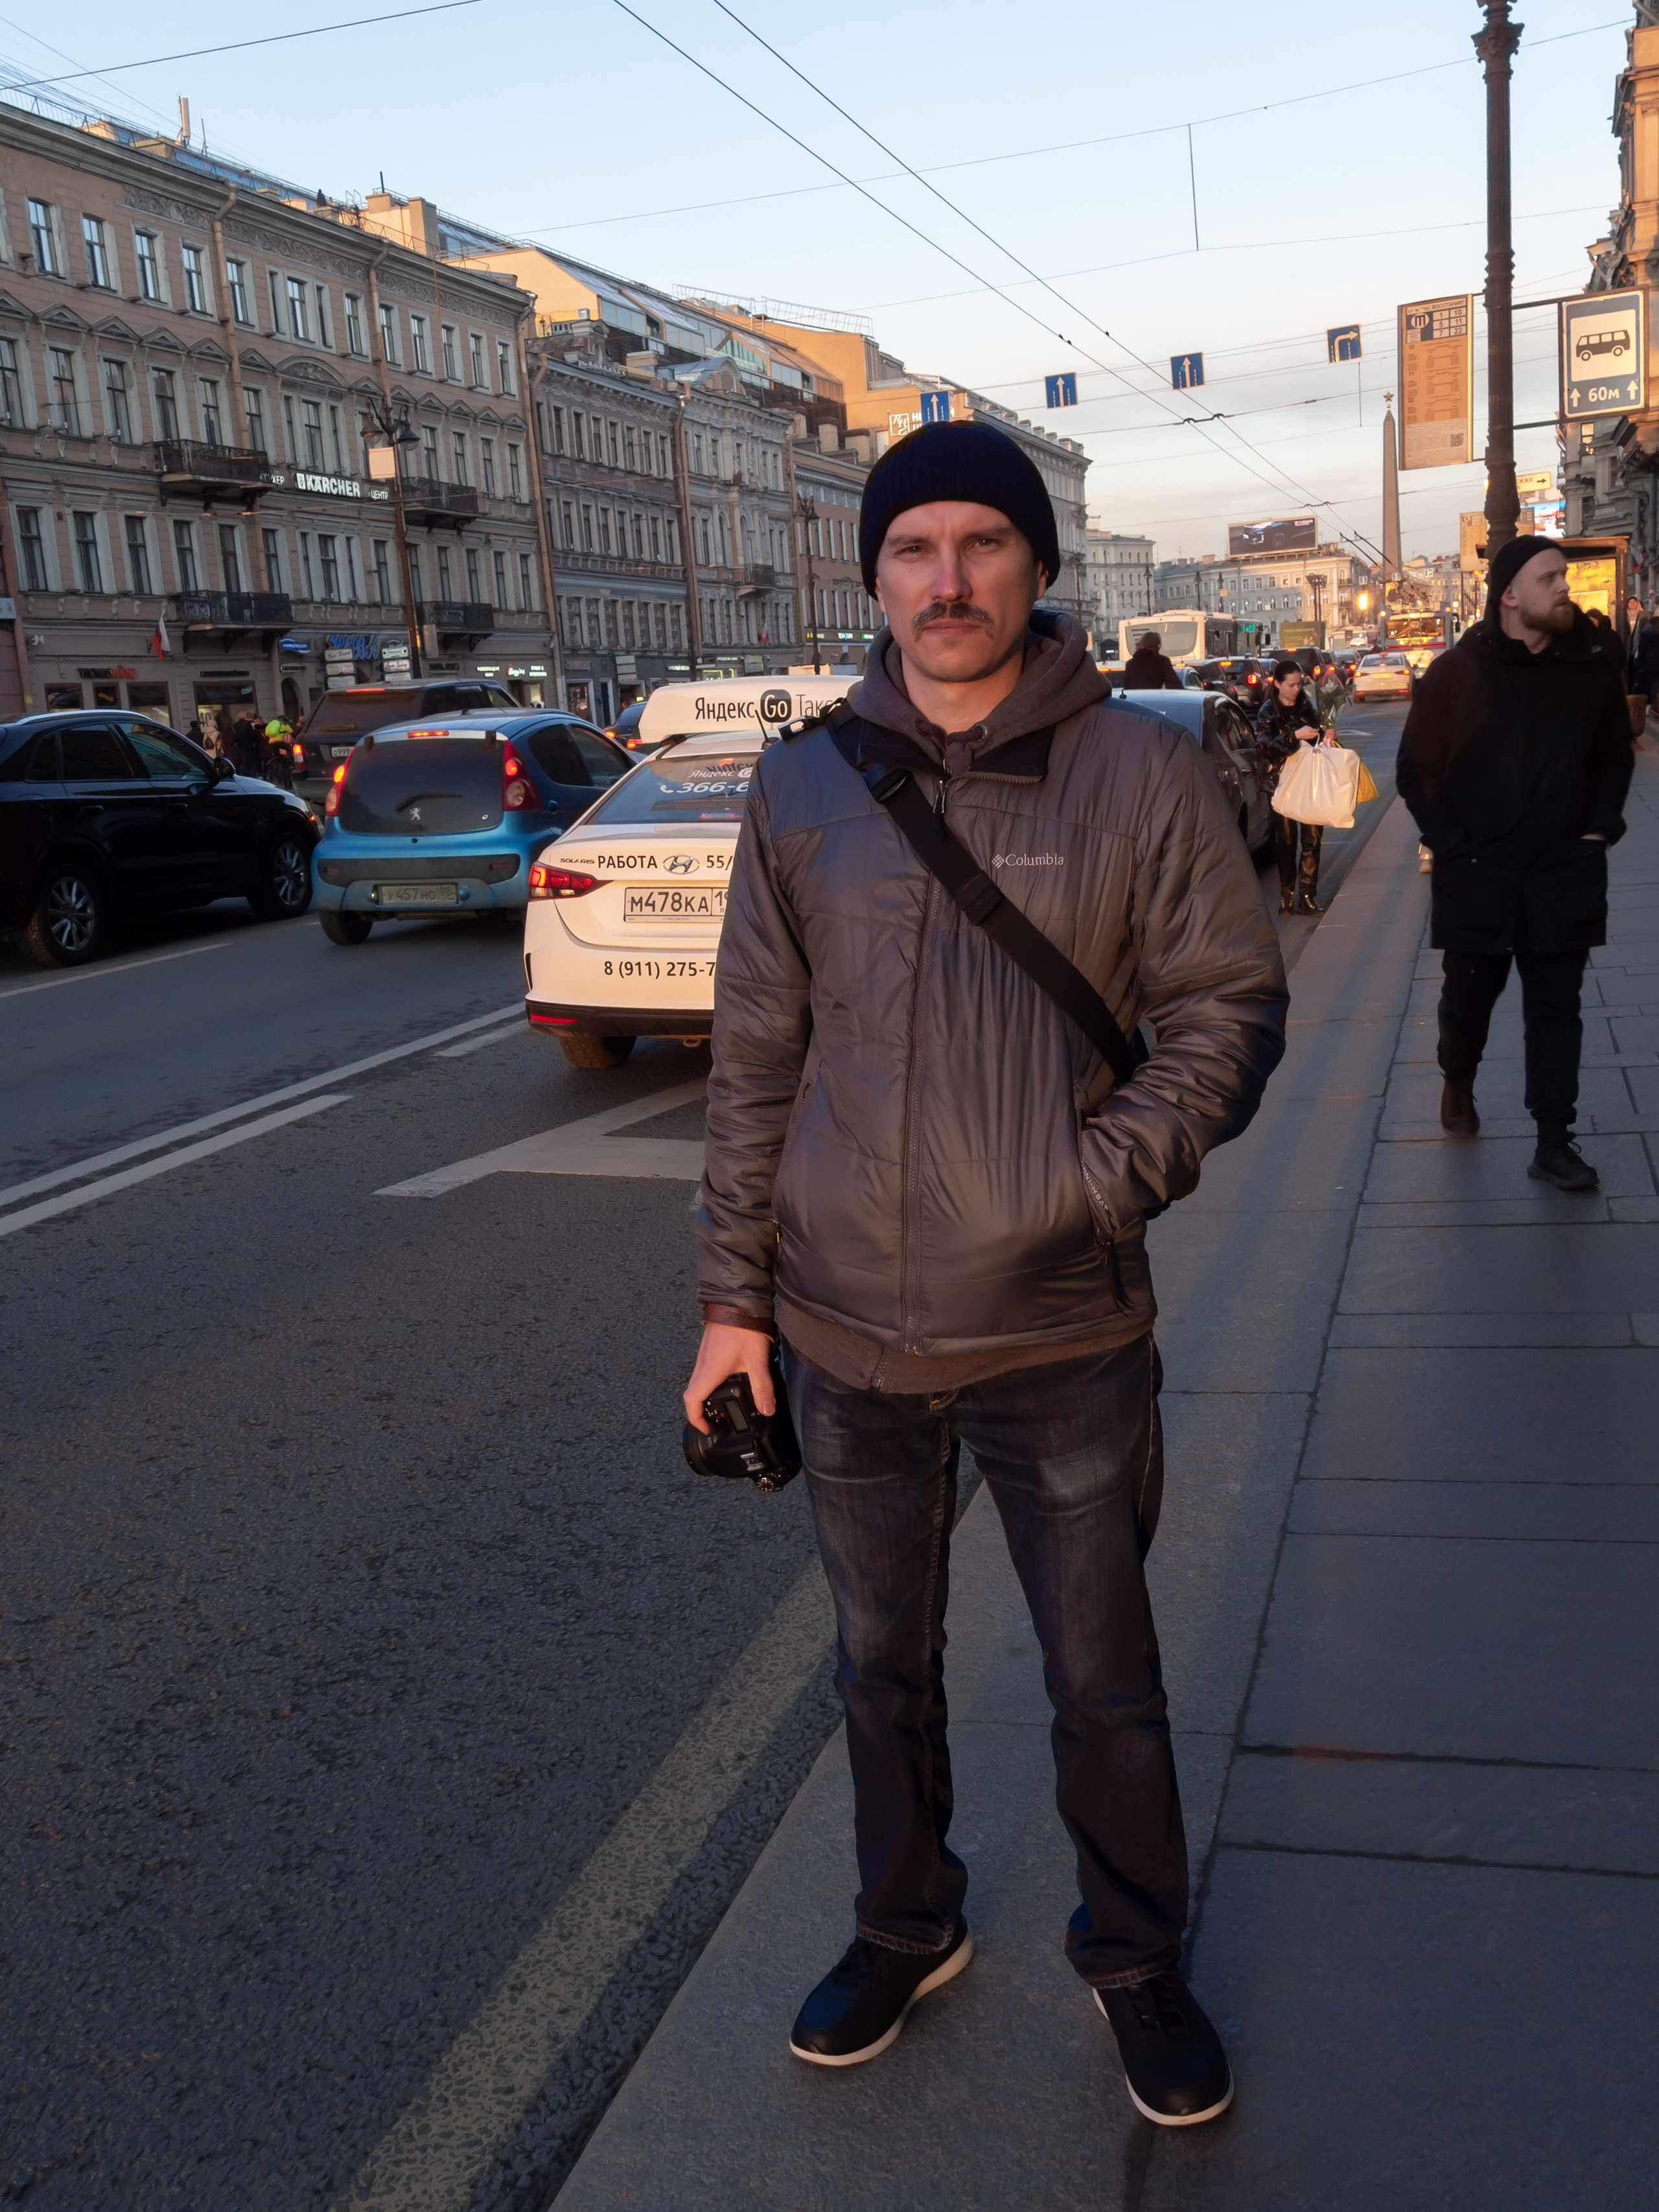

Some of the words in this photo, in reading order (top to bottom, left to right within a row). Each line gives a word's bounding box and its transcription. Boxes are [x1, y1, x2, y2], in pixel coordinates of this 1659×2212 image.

[1588, 386, 1620, 402] 60м
[305, 474, 361, 497] KÄRCHER
[371, 490, 389, 501] ЦЕНТР
[1163, 623, 1168, 634] 7
[695, 697, 755, 722] Яндекс
[764, 694, 788, 718] Go
[689, 770, 736, 778] Яндекс
[677, 781, 749, 793] 366-6
[598, 855, 658, 868] РАБОТА
[1005, 853, 1064, 867] Columbia
[630, 892, 709, 913] М478КА
[604, 960, 613, 975] 8
[618, 961, 660, 979] (911)
[667, 962, 715, 977] 275-7
